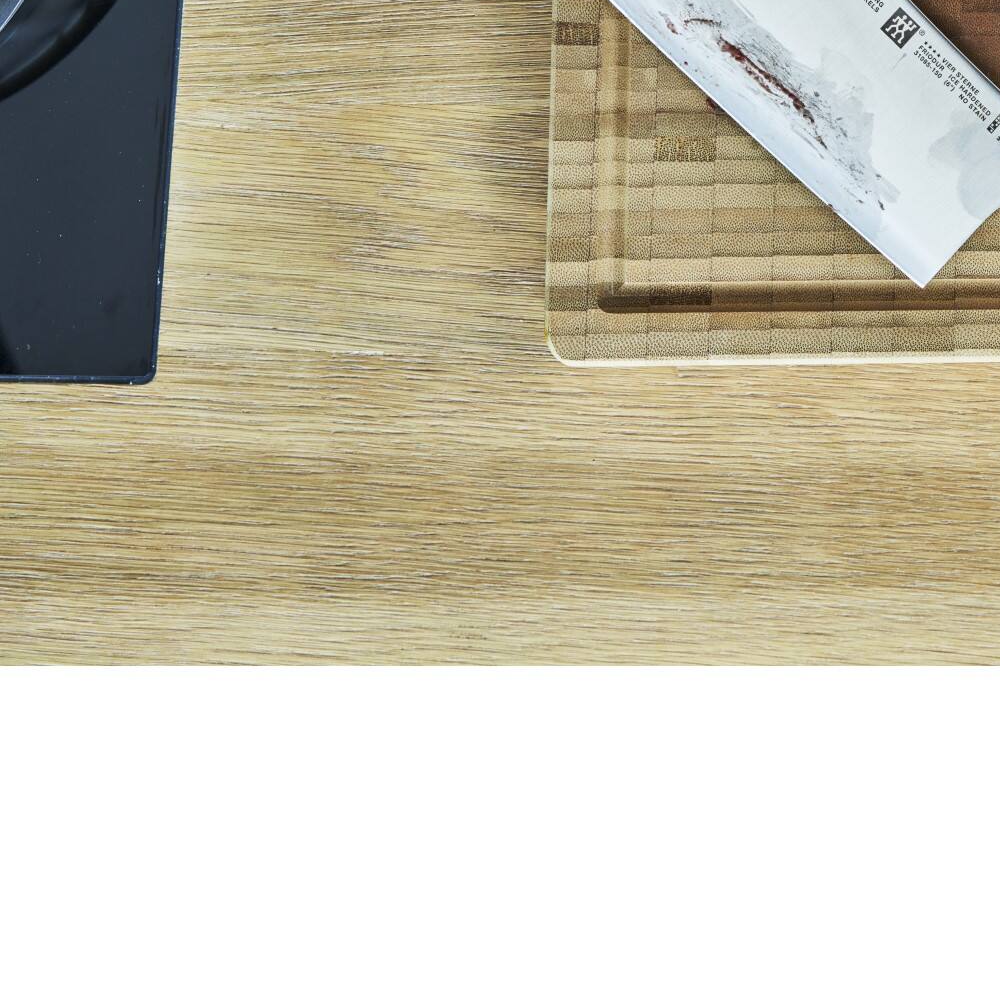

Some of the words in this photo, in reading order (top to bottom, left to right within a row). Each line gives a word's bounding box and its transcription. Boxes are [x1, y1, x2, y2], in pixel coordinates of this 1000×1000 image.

[918, 45, 945, 72] FRIODUR
[948, 73, 960, 86] ICE
[960, 83, 991, 117] HARDENED
[942, 57, 957, 73] VIER
[955, 71, 980, 96] STERNE
[958, 93, 969, 104] NO
[968, 104, 987, 122] STAIN
